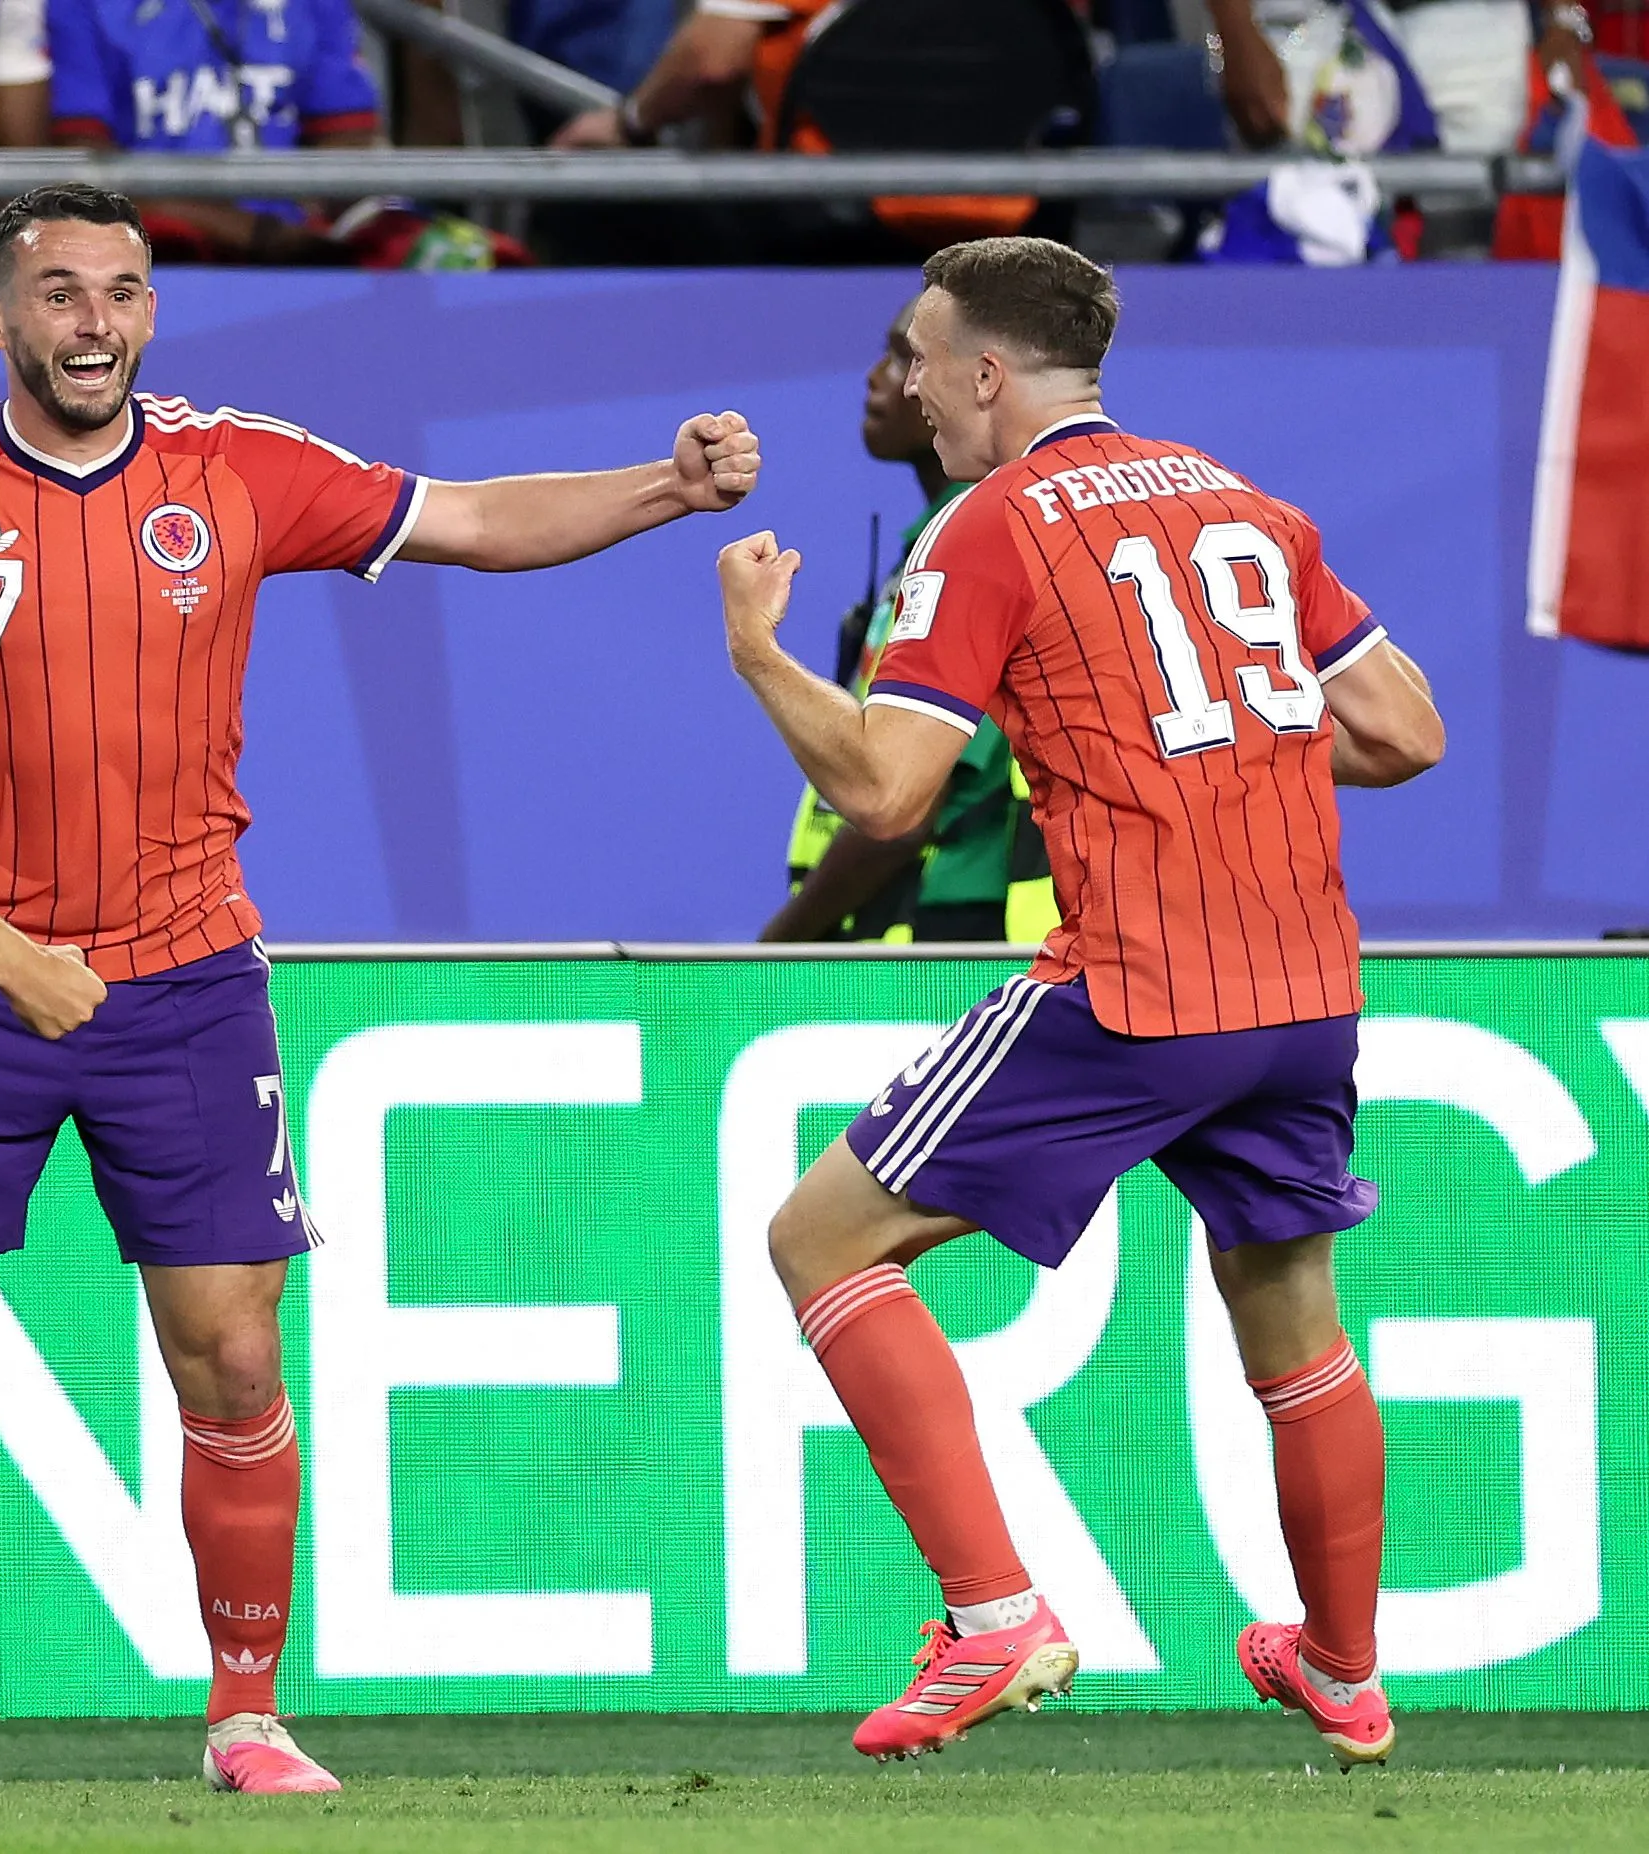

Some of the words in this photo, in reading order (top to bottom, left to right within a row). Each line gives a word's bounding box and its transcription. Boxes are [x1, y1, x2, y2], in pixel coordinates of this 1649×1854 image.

[1106, 520, 1326, 760] 19
[253, 1074, 286, 1177] 7
[212, 1597, 281, 1621] ALBA
